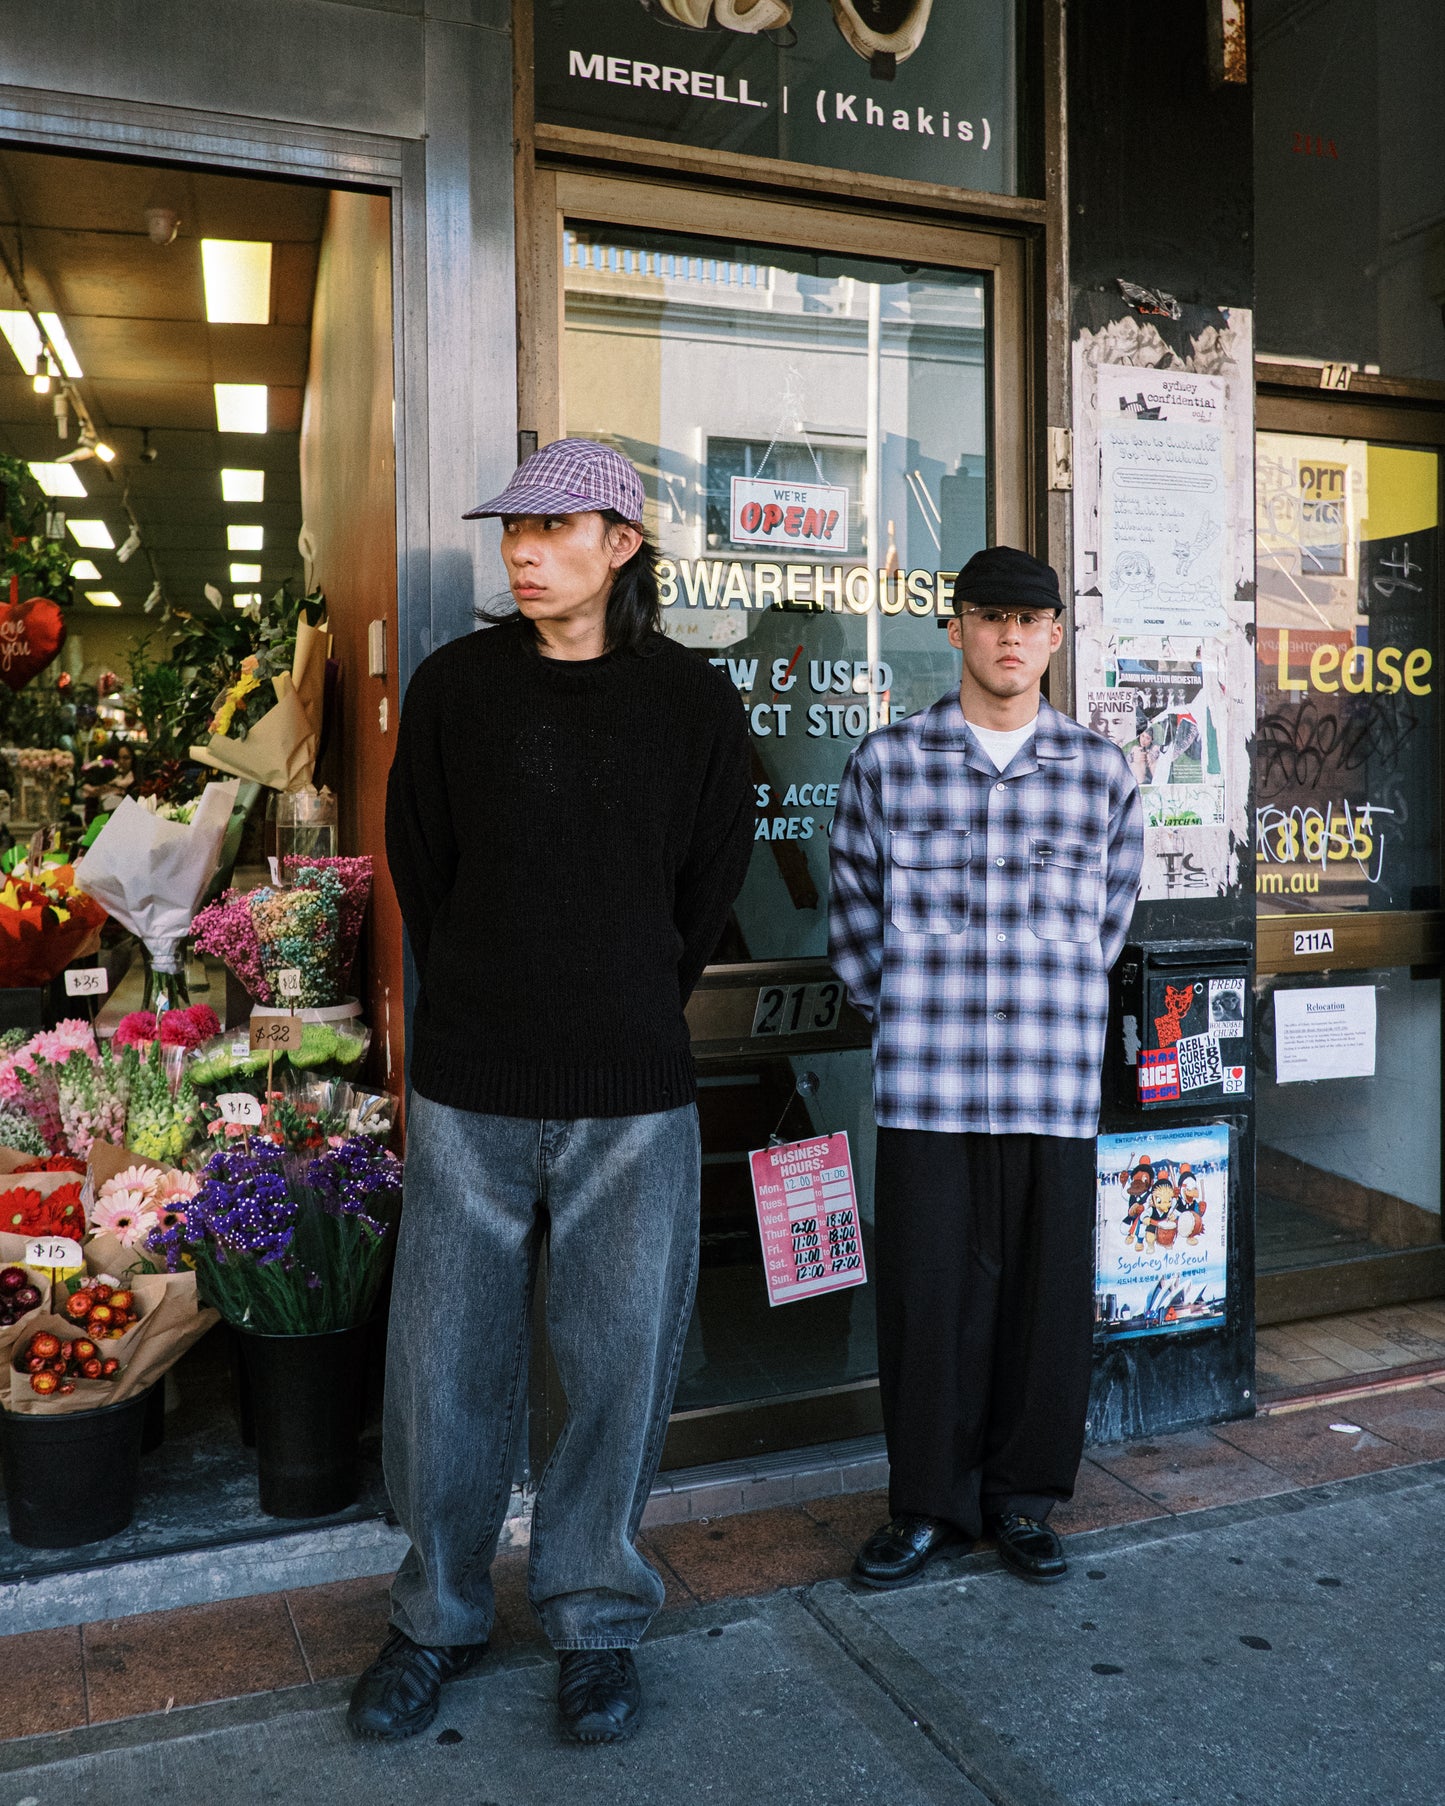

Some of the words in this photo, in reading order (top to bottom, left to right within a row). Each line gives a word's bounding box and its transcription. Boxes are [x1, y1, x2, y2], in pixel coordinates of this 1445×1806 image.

[816, 90, 992, 150] (Khakis)
[1147, 394, 1216, 409] confidential
[773, 490, 807, 503] WE'RE
[740, 501, 840, 540] OPEN!
[1278, 629, 1432, 696] Lease
[810, 660, 893, 693] USED
[1107, 692, 1126, 701] NAME
[1088, 702, 1134, 713] DENNIS
[1295, 933, 1332, 952] 211A
[757, 984, 839, 1033] 213
[1306, 1001, 1345, 1012] Relocation
[255, 1024, 290, 1043] $22
[1180, 1049, 1205, 1065] CURE
[1139, 1064, 1177, 1087] RICE
[1181, 1060, 1207, 1077] NUSH
[1226, 1080, 1242, 1092] SP
[228, 1101, 251, 1115] $15
[770, 1143, 829, 1166] BUSINESS
[781, 1158, 824, 1177] HOURS:
[759, 1184, 782, 1196] Mon.
[761, 1199, 785, 1210] Tues.
[763, 1213, 786, 1226] Wed.
[765, 1229, 789, 1241] Thur.
[826, 1210, 853, 1227] 18:00
[34, 1243, 66, 1259] $15
[767, 1244, 782, 1256] Fri.
[793, 1234, 818, 1252] 11:00
[769, 1259, 788, 1271] Sat.
[795, 1248, 820, 1266] 11:00
[1117, 1257, 1162, 1274] Sydney
[1179, 1251, 1208, 1269] Seoul
[771, 1273, 792, 1285] Sun.
[797, 1264, 825, 1281] 12:00
